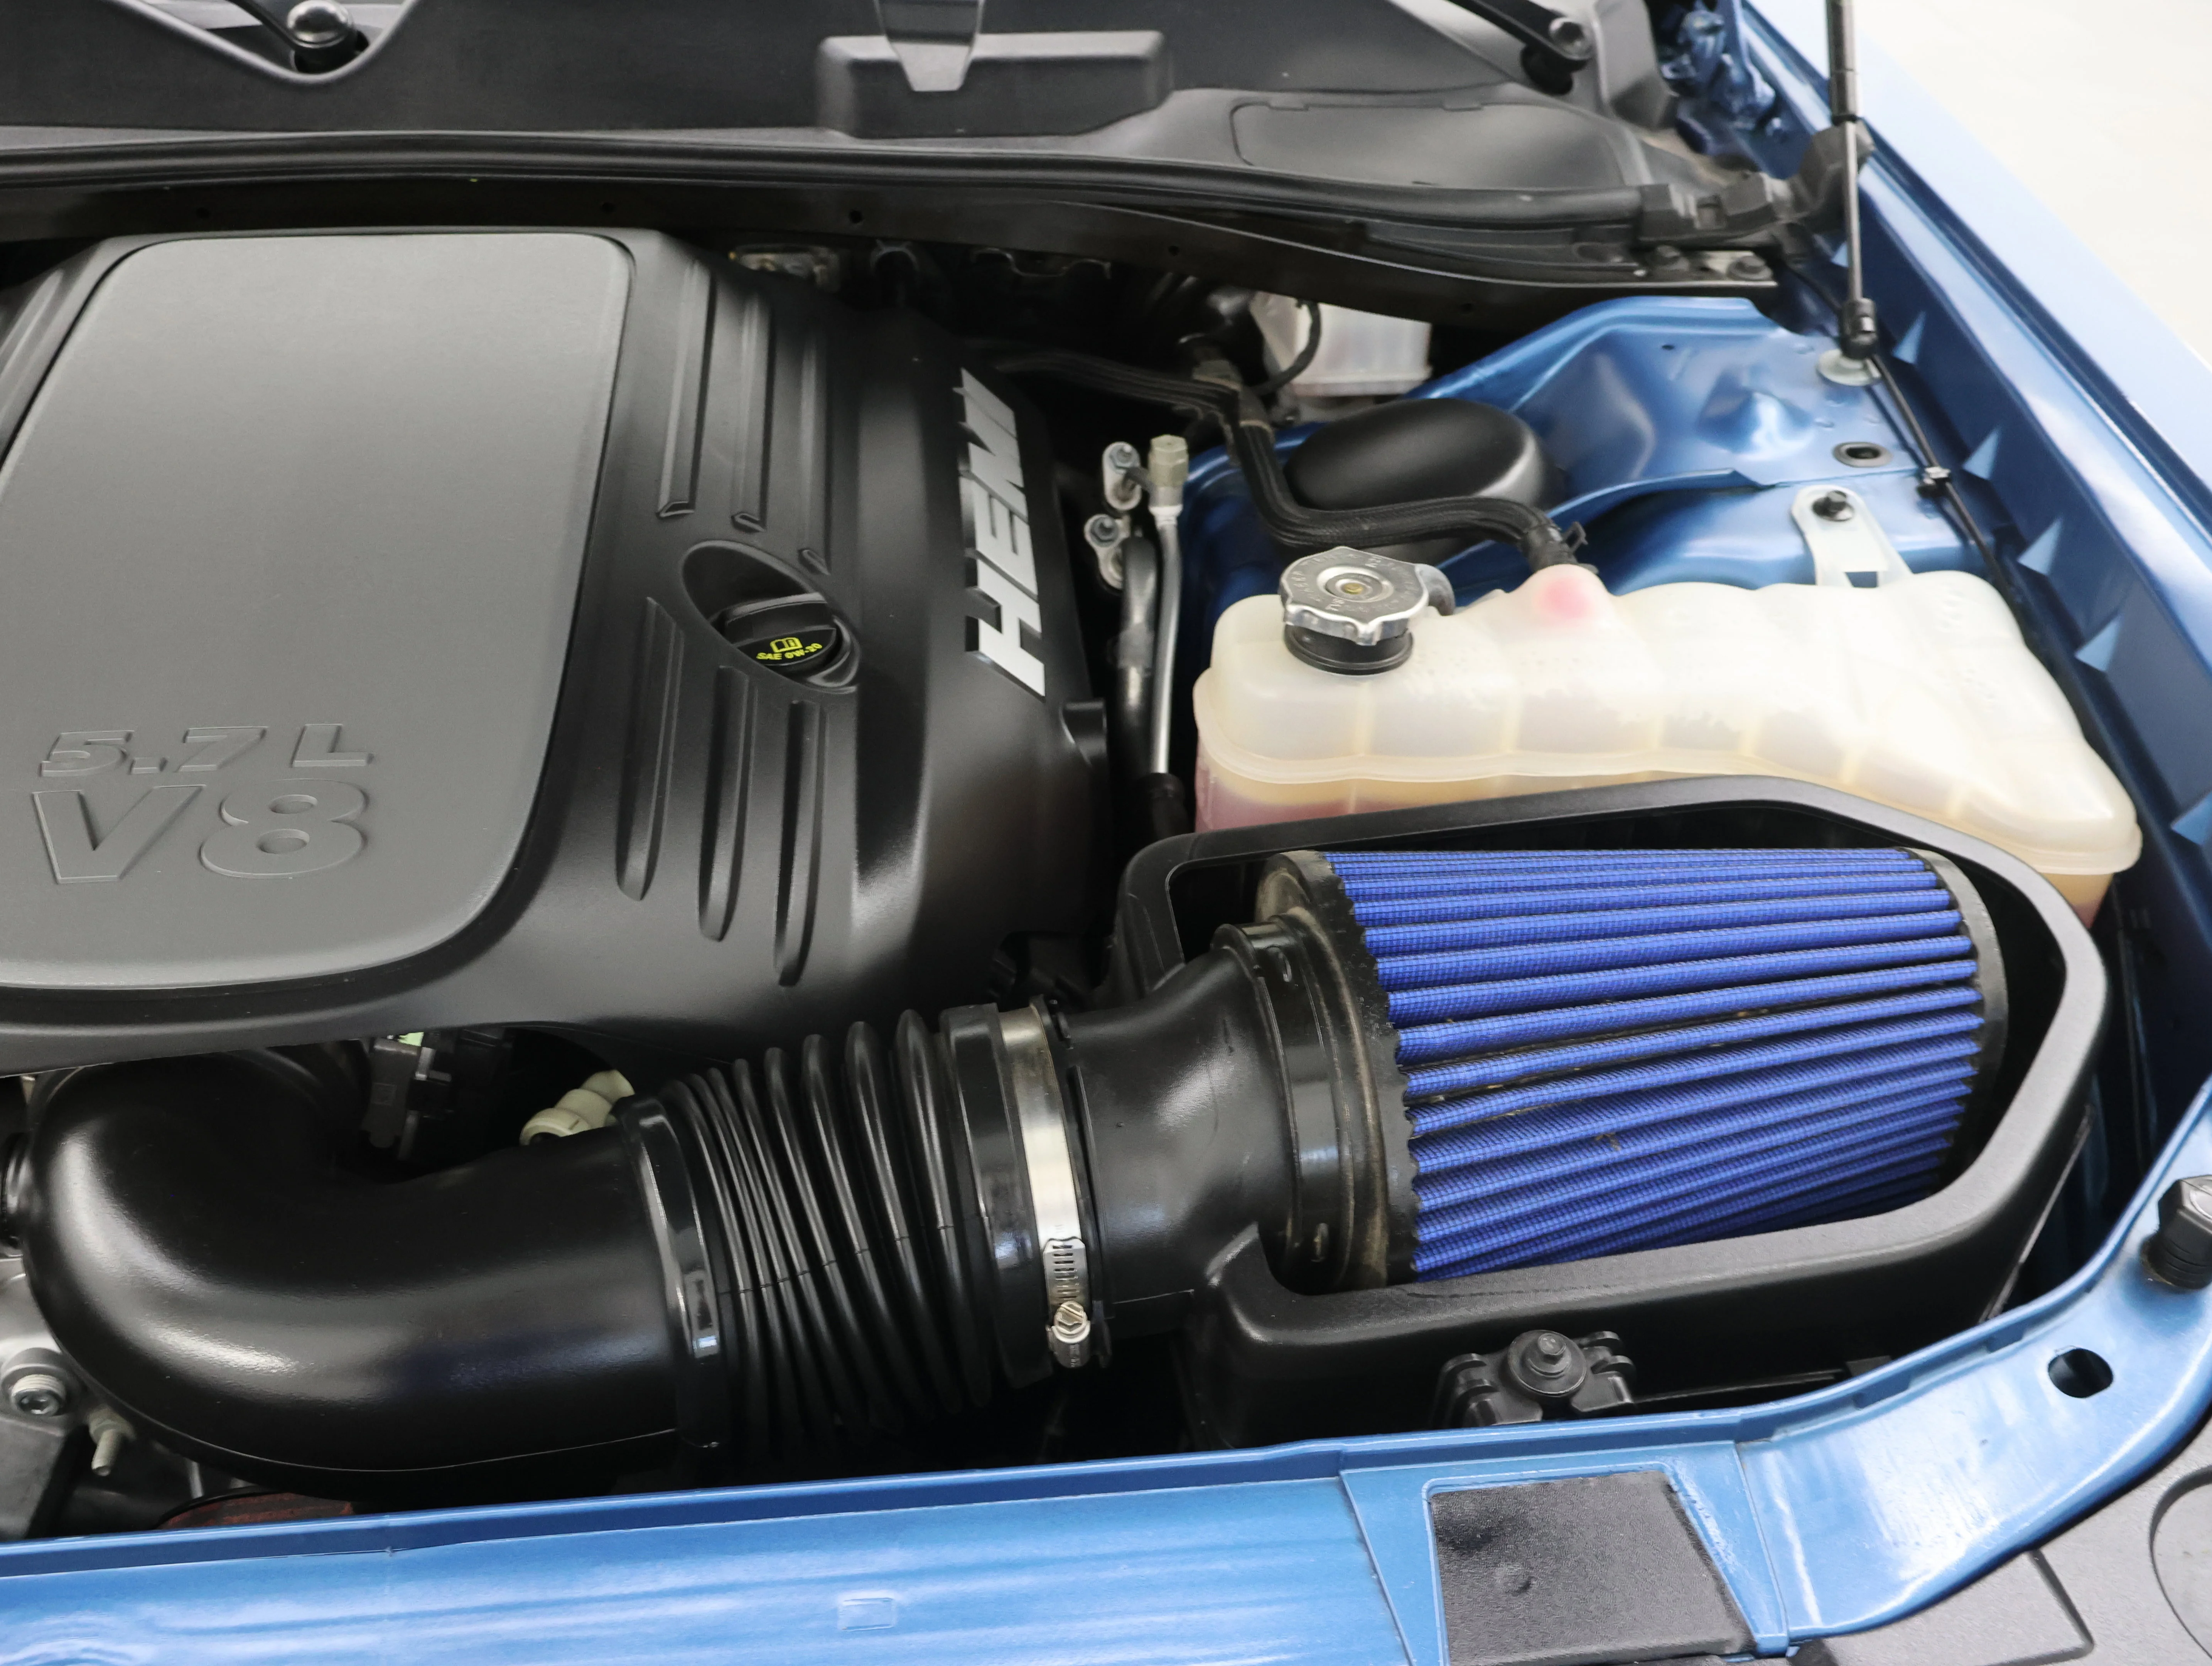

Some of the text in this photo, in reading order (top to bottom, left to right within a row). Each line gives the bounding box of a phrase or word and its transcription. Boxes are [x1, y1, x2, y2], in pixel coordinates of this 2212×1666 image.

[955, 368, 1046, 700] HEMI
[785, 643, 822, 659] 0W-20
[32, 778, 369, 884] V8
